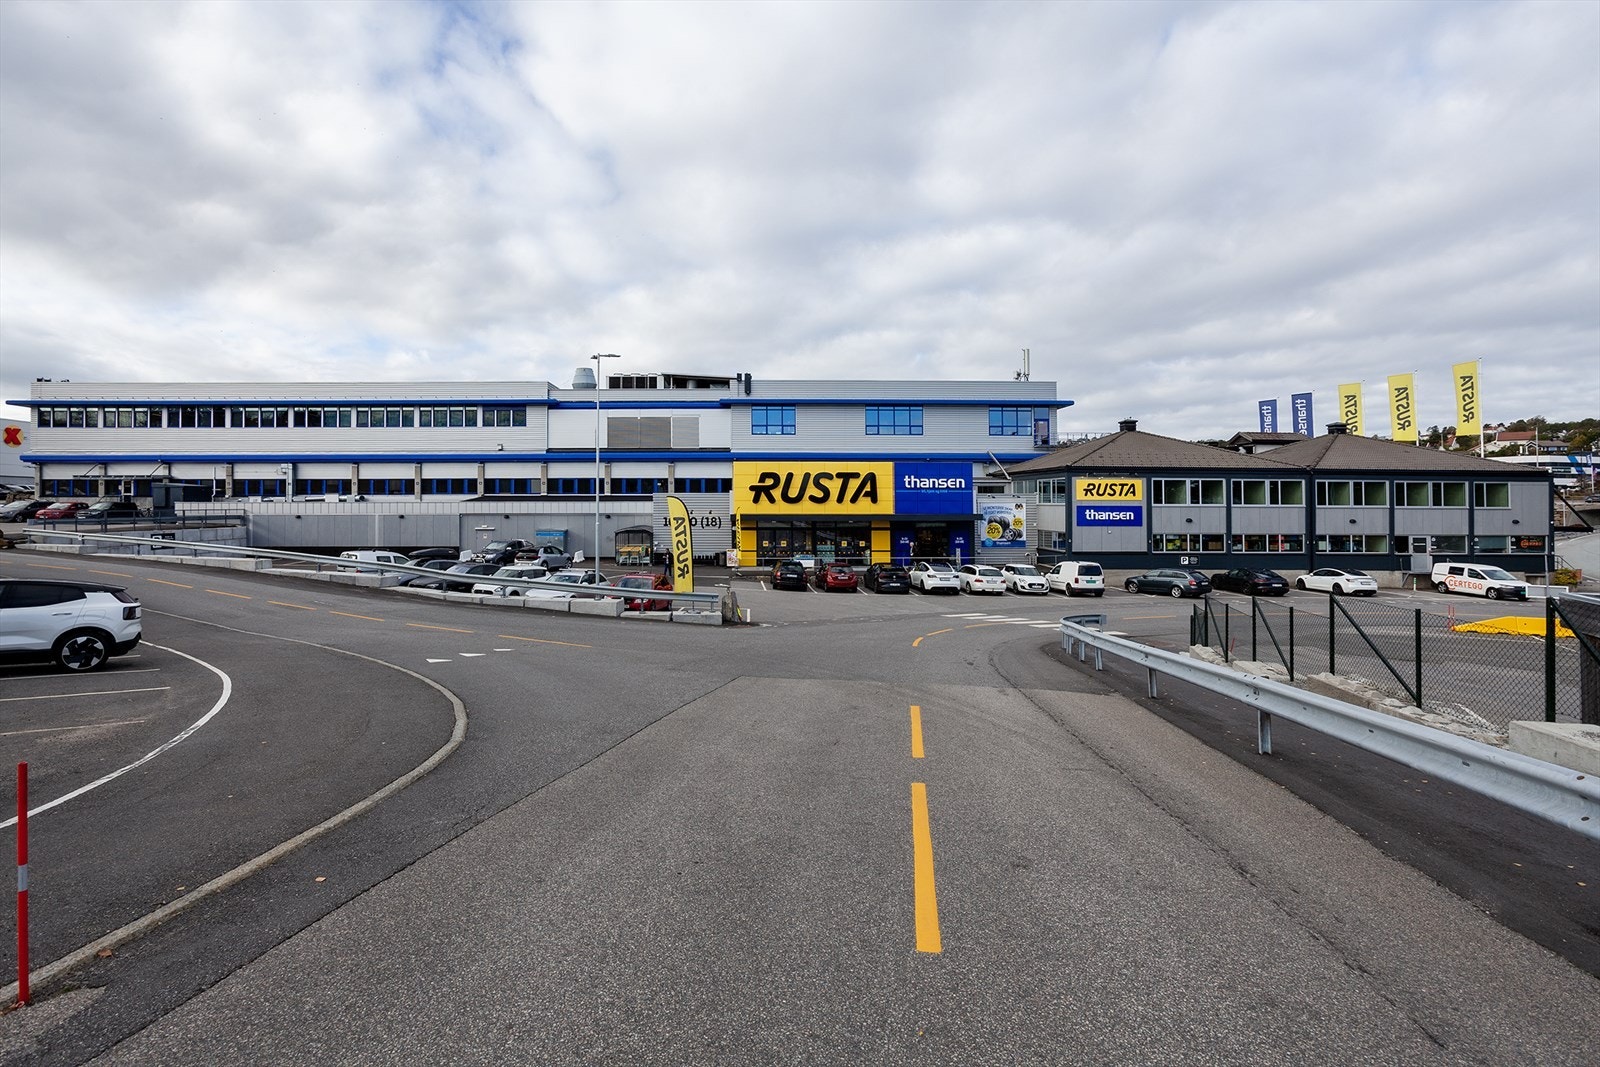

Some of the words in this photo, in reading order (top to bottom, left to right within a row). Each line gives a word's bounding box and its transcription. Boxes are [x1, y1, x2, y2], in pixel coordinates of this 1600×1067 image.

[749, 472, 878, 504] RUSTA
[904, 475, 965, 488] thansen
[1083, 483, 1136, 497] RUSTA
[1085, 509, 1134, 520] thansen
[701, 516, 721, 529] (18)
[1448, 578, 1483, 590] CERTEGO
